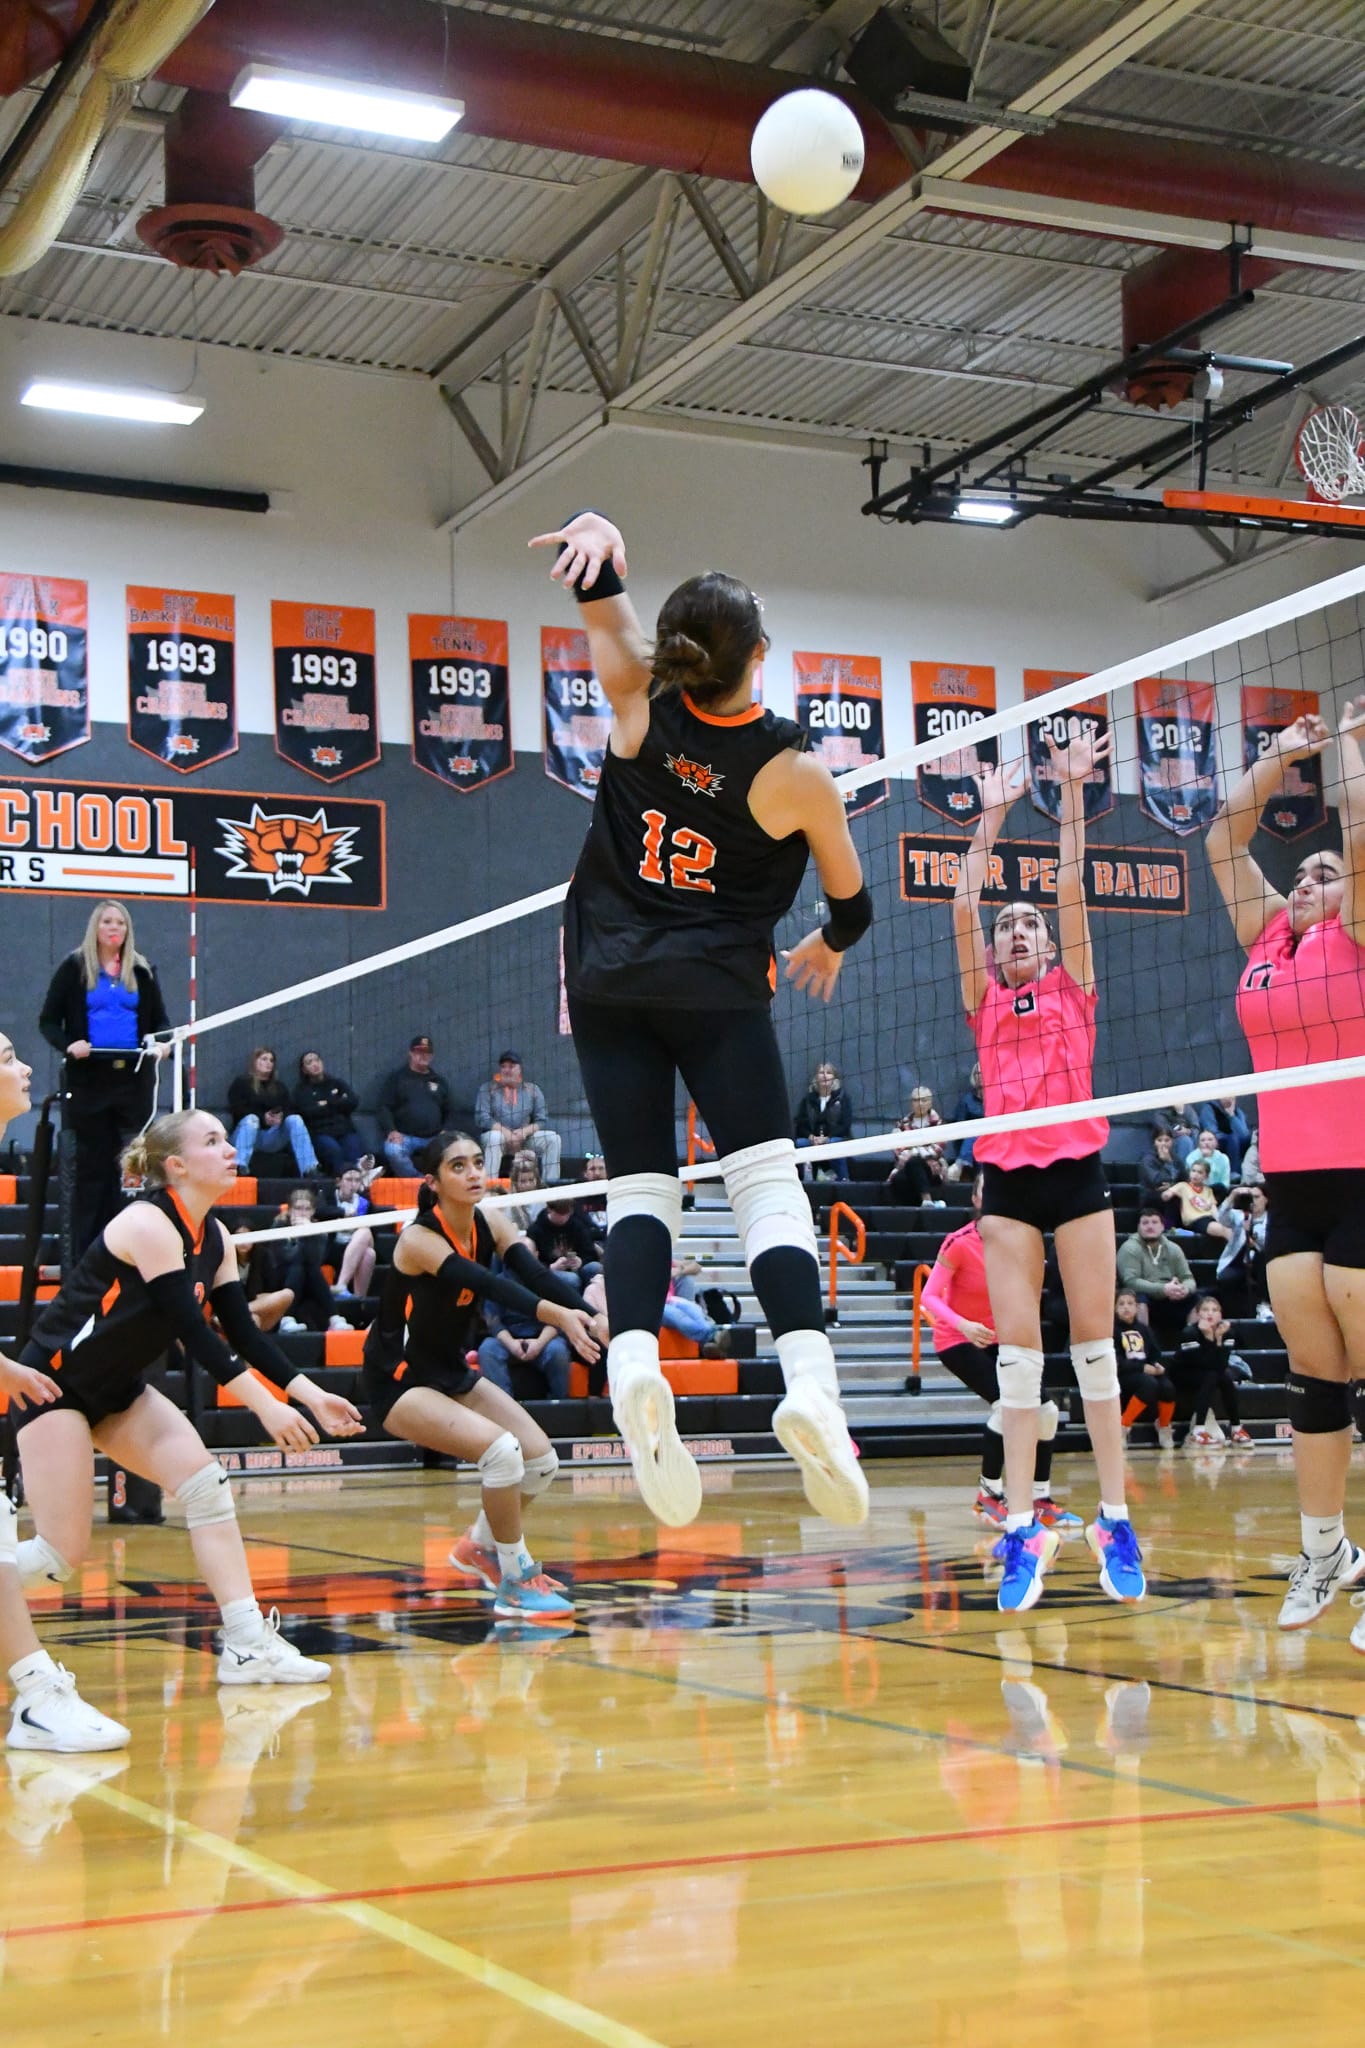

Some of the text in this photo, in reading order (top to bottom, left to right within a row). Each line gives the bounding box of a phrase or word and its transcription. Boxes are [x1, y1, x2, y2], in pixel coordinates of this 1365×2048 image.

[0, 626, 68, 663] 1990
[146, 639, 216, 675] 1993
[431, 636, 488, 655] TENNIS
[291, 653, 358, 688] 1993
[428, 665, 492, 698] 1993
[560, 677, 609, 708] 199
[808, 698, 871, 731] 2000
[638, 808, 717, 894] 12
[908, 849, 1180, 899] TIGR PE BAND
[244, 1451, 283, 1469] HIGH
